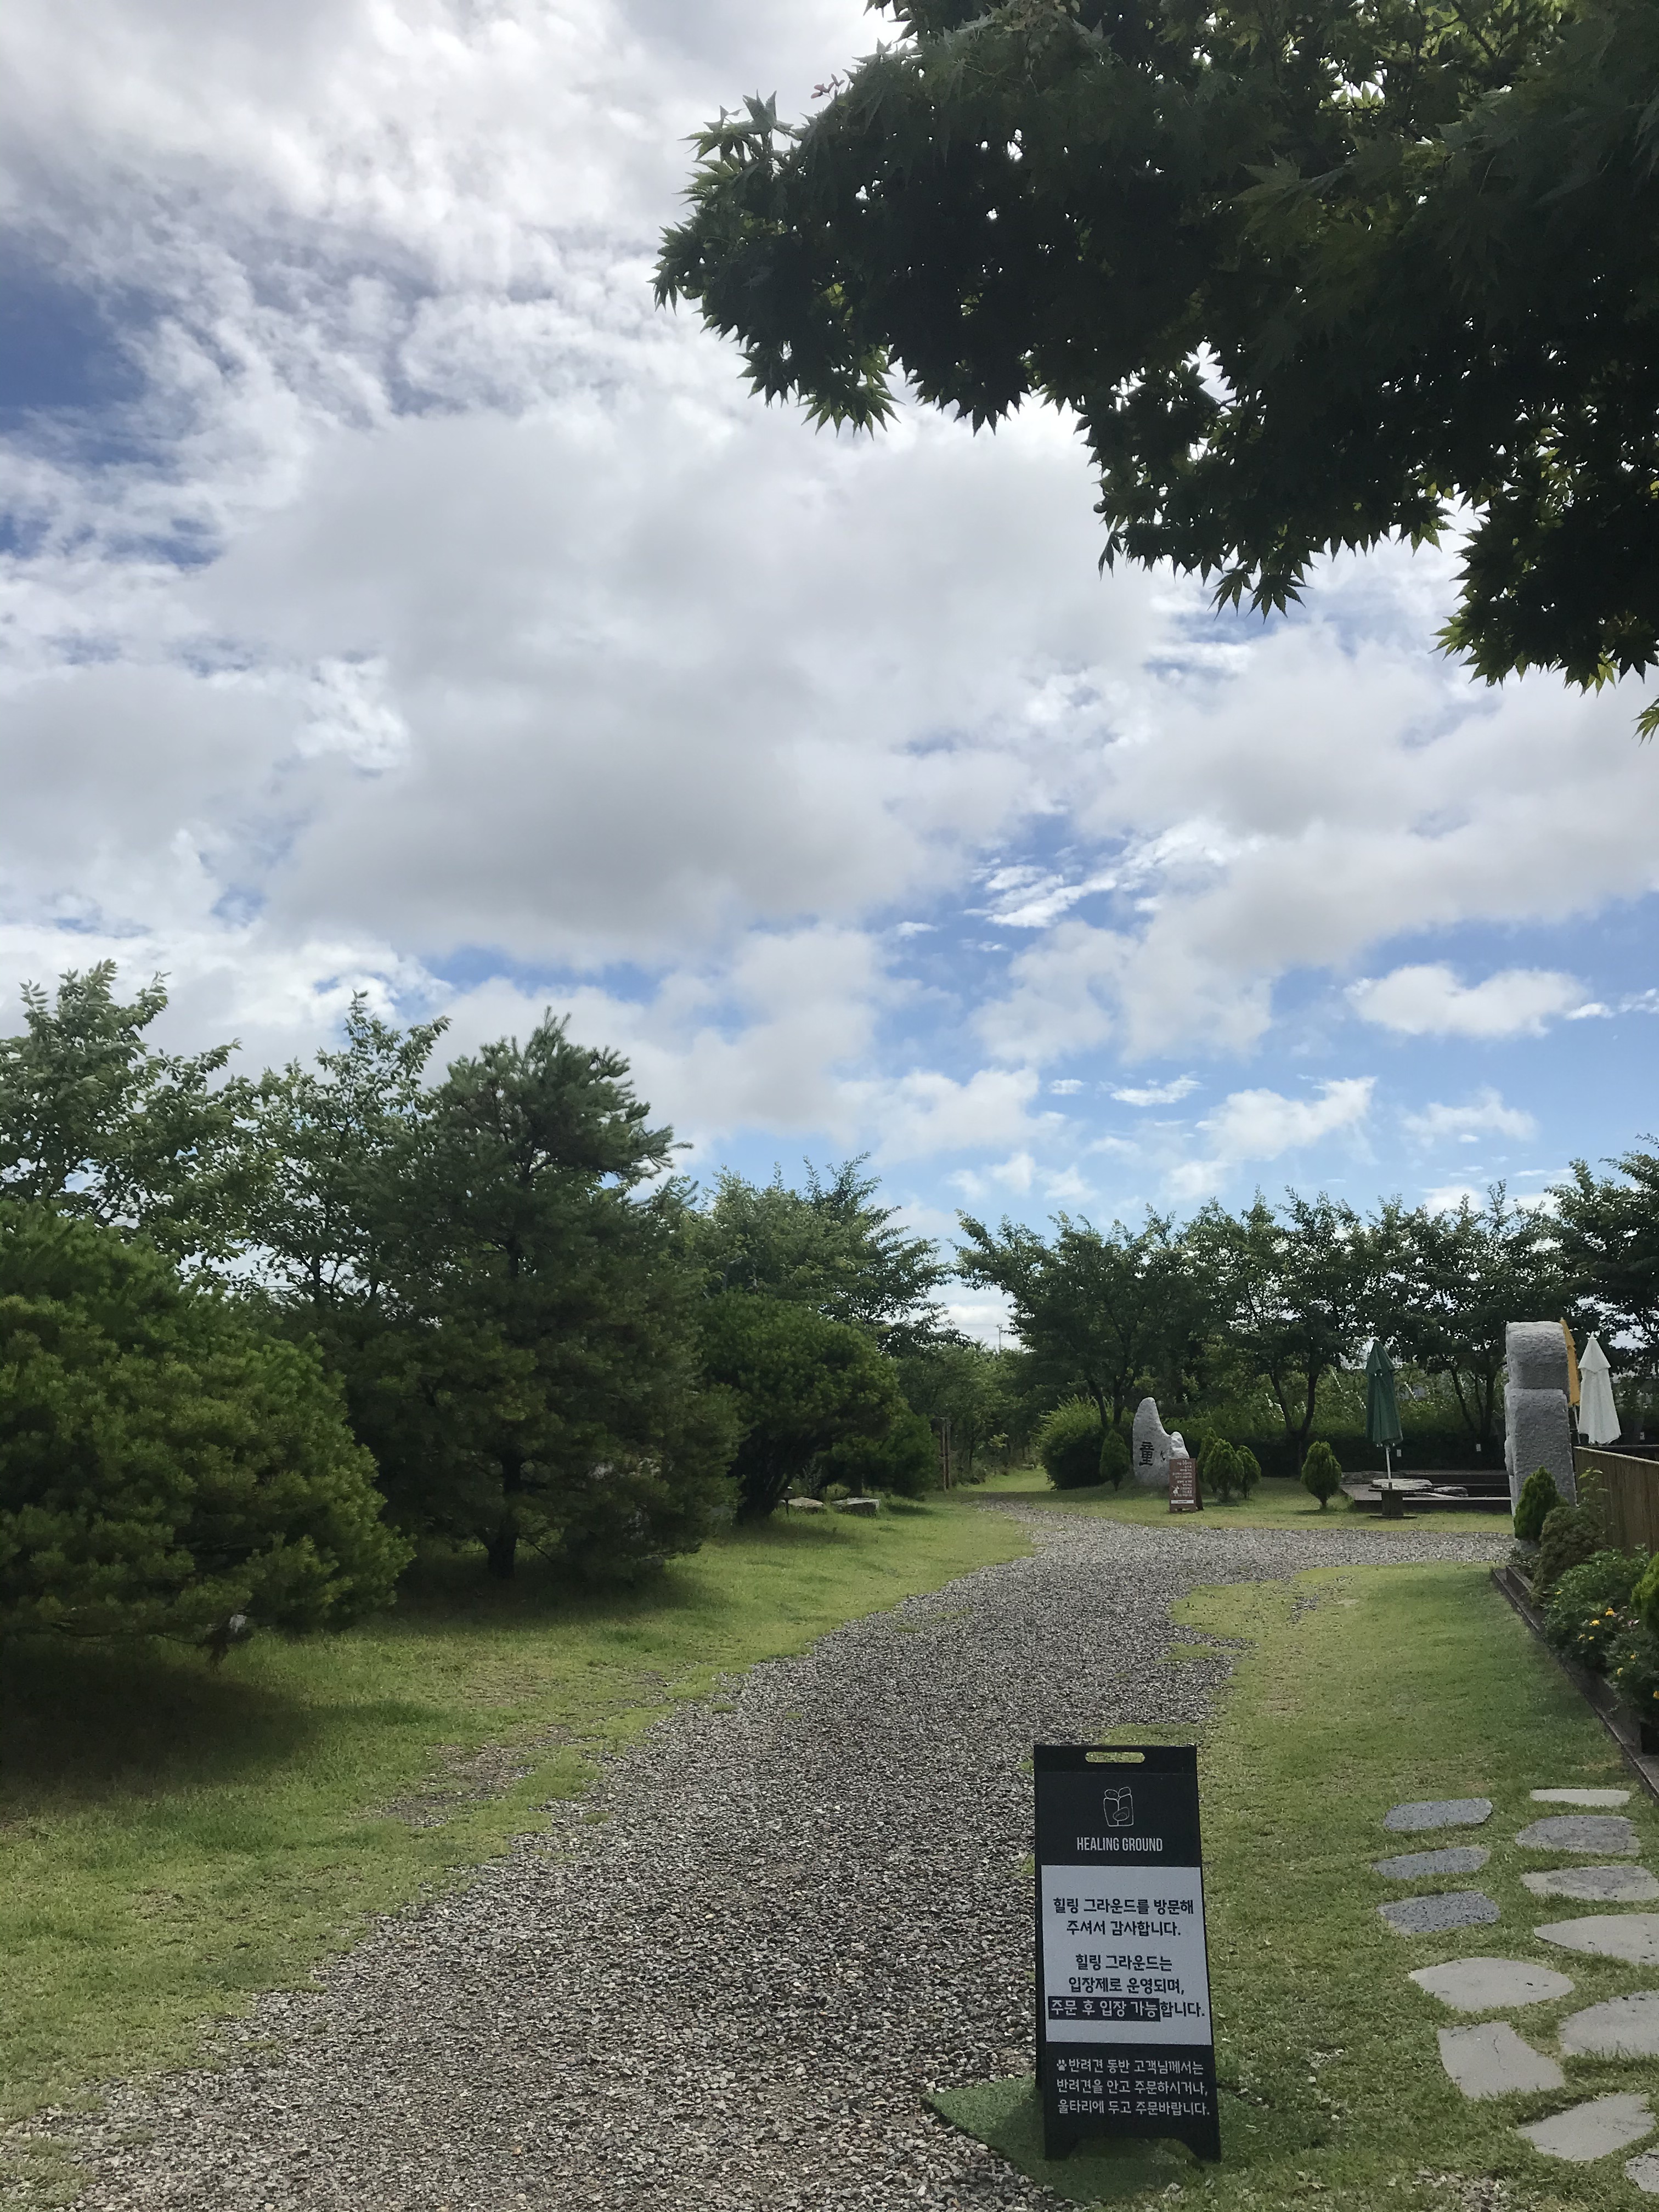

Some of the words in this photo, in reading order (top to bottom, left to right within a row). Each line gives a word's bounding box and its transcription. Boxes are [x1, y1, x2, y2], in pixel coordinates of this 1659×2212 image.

[1077, 1837, 1119, 1851] HEALING
[1122, 1838, 1163, 1852] GROUND
[1053, 1897, 1079, 1914] 힐링
[1084, 1899, 1149, 1915] 그라운드를
[1154, 1900, 1194, 1915] 방문해
[1066, 1920, 1105, 1935] 주셔서
[1110, 1921, 1181, 1937] 감사합니다.
[1075, 1954, 1101, 1971] 힐링
[1105, 1955, 1172, 1972] 그라운드는
[1069, 1977, 1122, 1994] 입장제로
[1127, 1977, 1184, 1995] 운영되며,
[1051, 1999, 1077, 2016] 주문
[1082, 2000, 1095, 2016] 후
[1099, 2000, 1127, 2017] 입장
[1130, 2001, 1205, 2018] 가능합니다.
[1069, 2058, 1103, 2073] 반려견
[1107, 2059, 1130, 2074] 동반
[1134, 2060, 1204, 2075] 고객님께서는
[1057, 2079, 1103, 2094] 반려견을
[1107, 2080, 1131, 2094] 안고
[1135, 2080, 1207, 2096] 주문하시거나,
[1058, 2099, 1104, 2114] 울타리에
[1108, 2101, 1131, 2114] 두고
[1136, 2101, 1210, 2116] 주문바랍니다.
